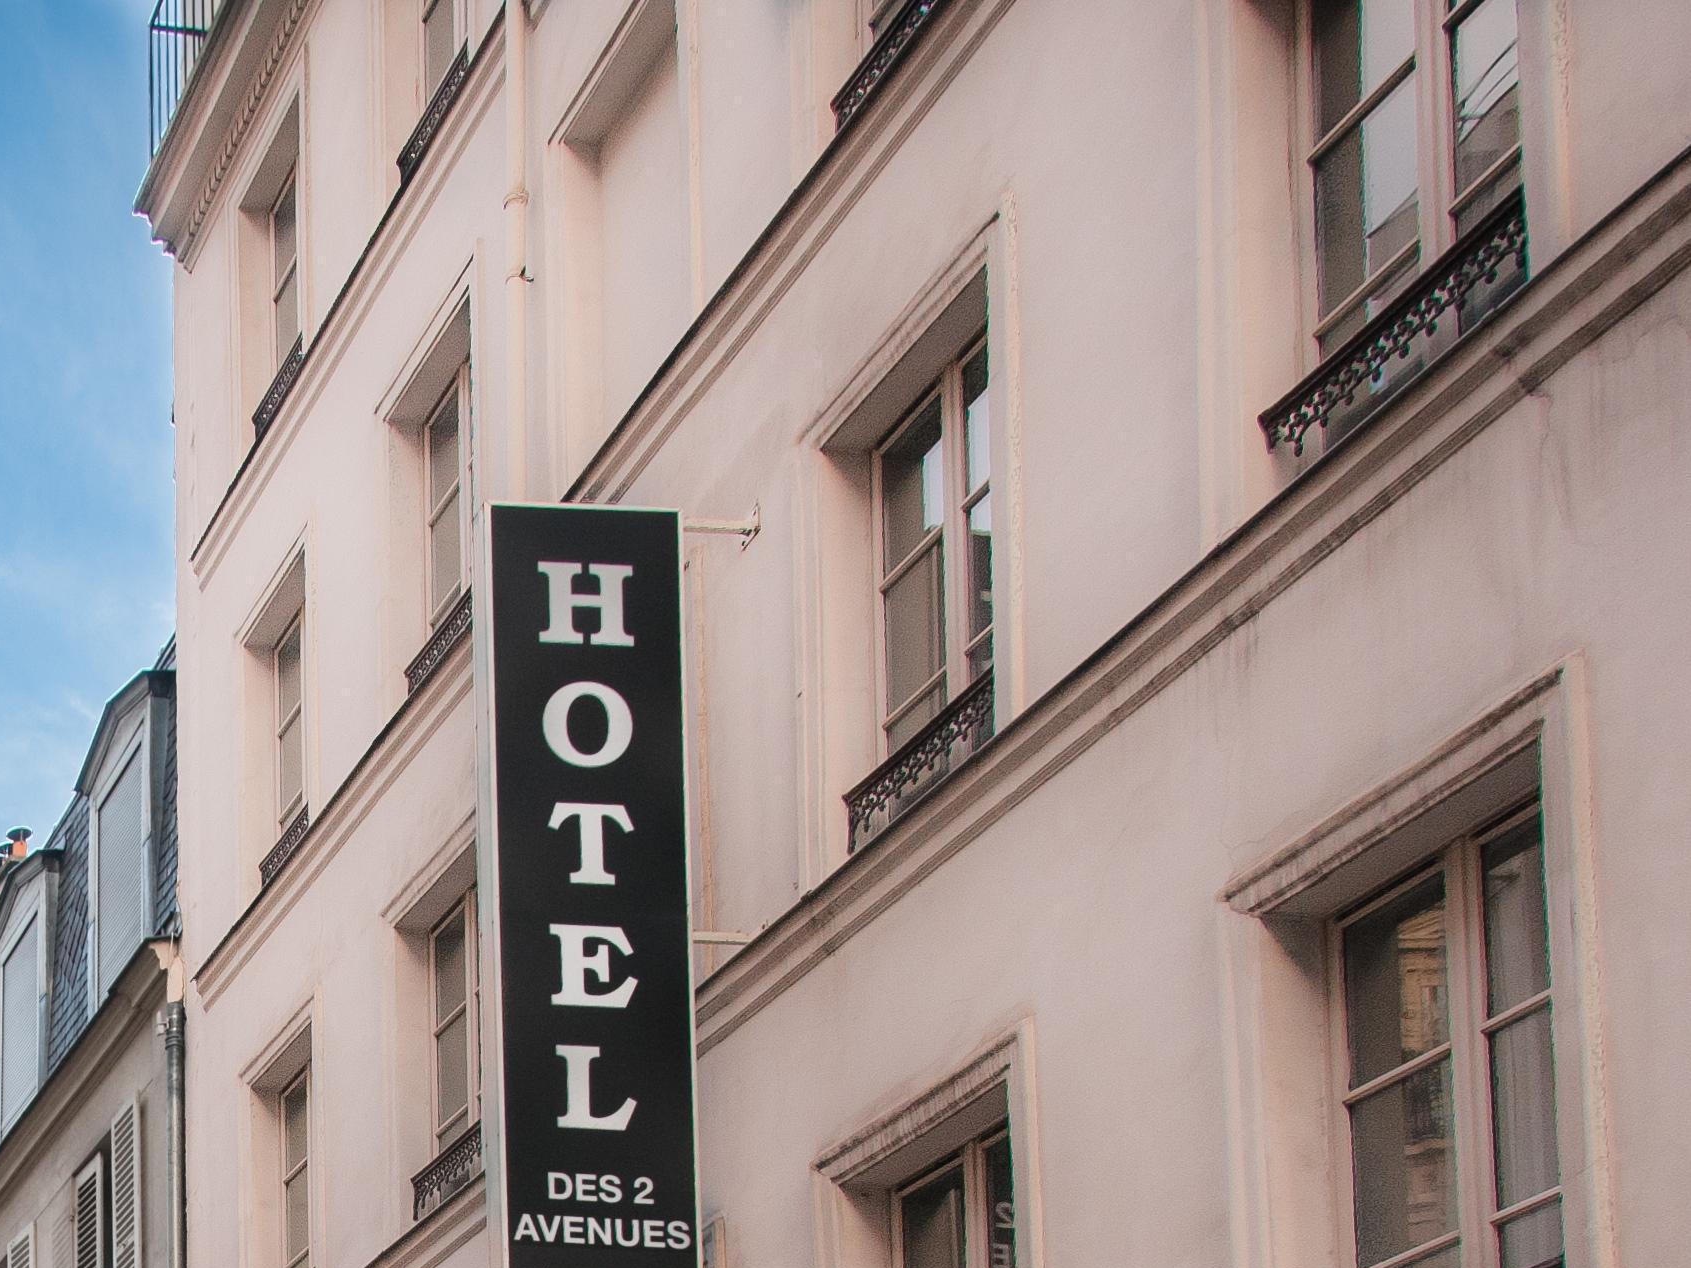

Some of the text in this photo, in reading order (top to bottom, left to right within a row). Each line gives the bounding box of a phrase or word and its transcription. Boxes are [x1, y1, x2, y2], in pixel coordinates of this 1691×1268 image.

[537, 561, 638, 1132] HOTEL
[547, 1172, 656, 1206] DES 2
[513, 1213, 691, 1250] AVENUES
